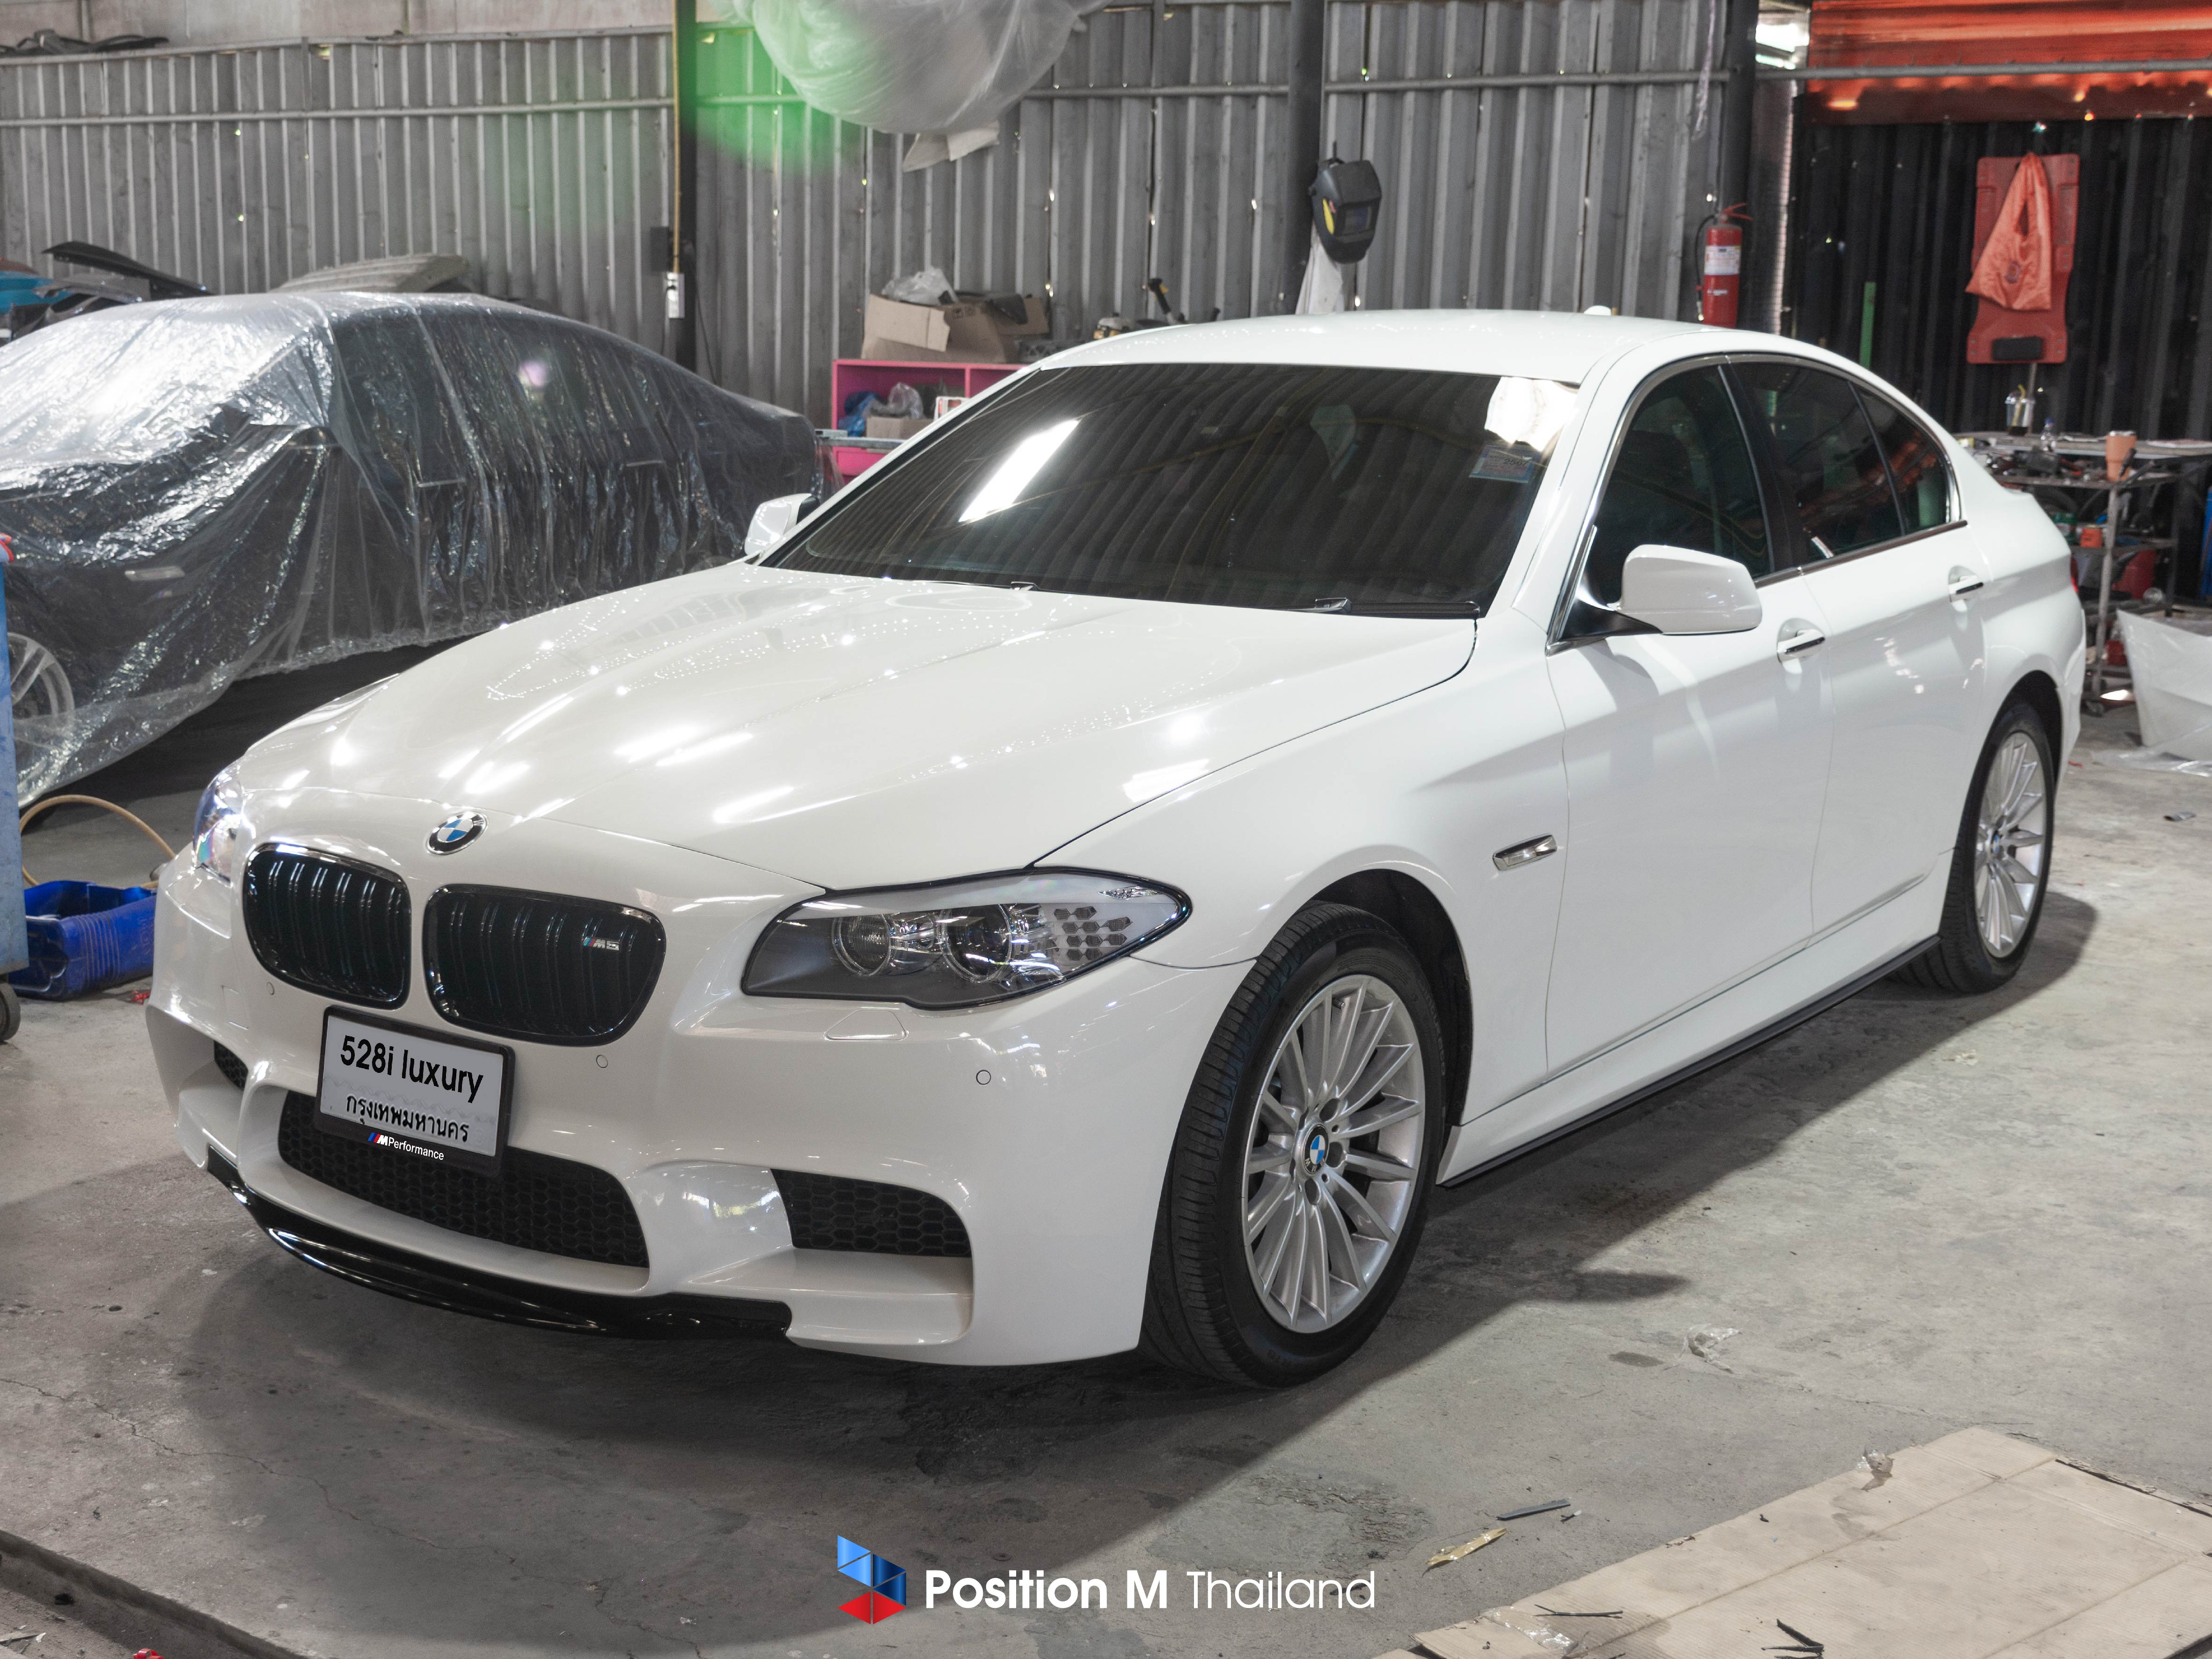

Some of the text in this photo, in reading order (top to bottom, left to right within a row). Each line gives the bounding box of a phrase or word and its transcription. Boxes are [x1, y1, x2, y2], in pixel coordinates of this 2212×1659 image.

[340, 1035, 483, 1103] 528i luxury
[346, 1094, 469, 1142] กรุงเทพมหานคร
